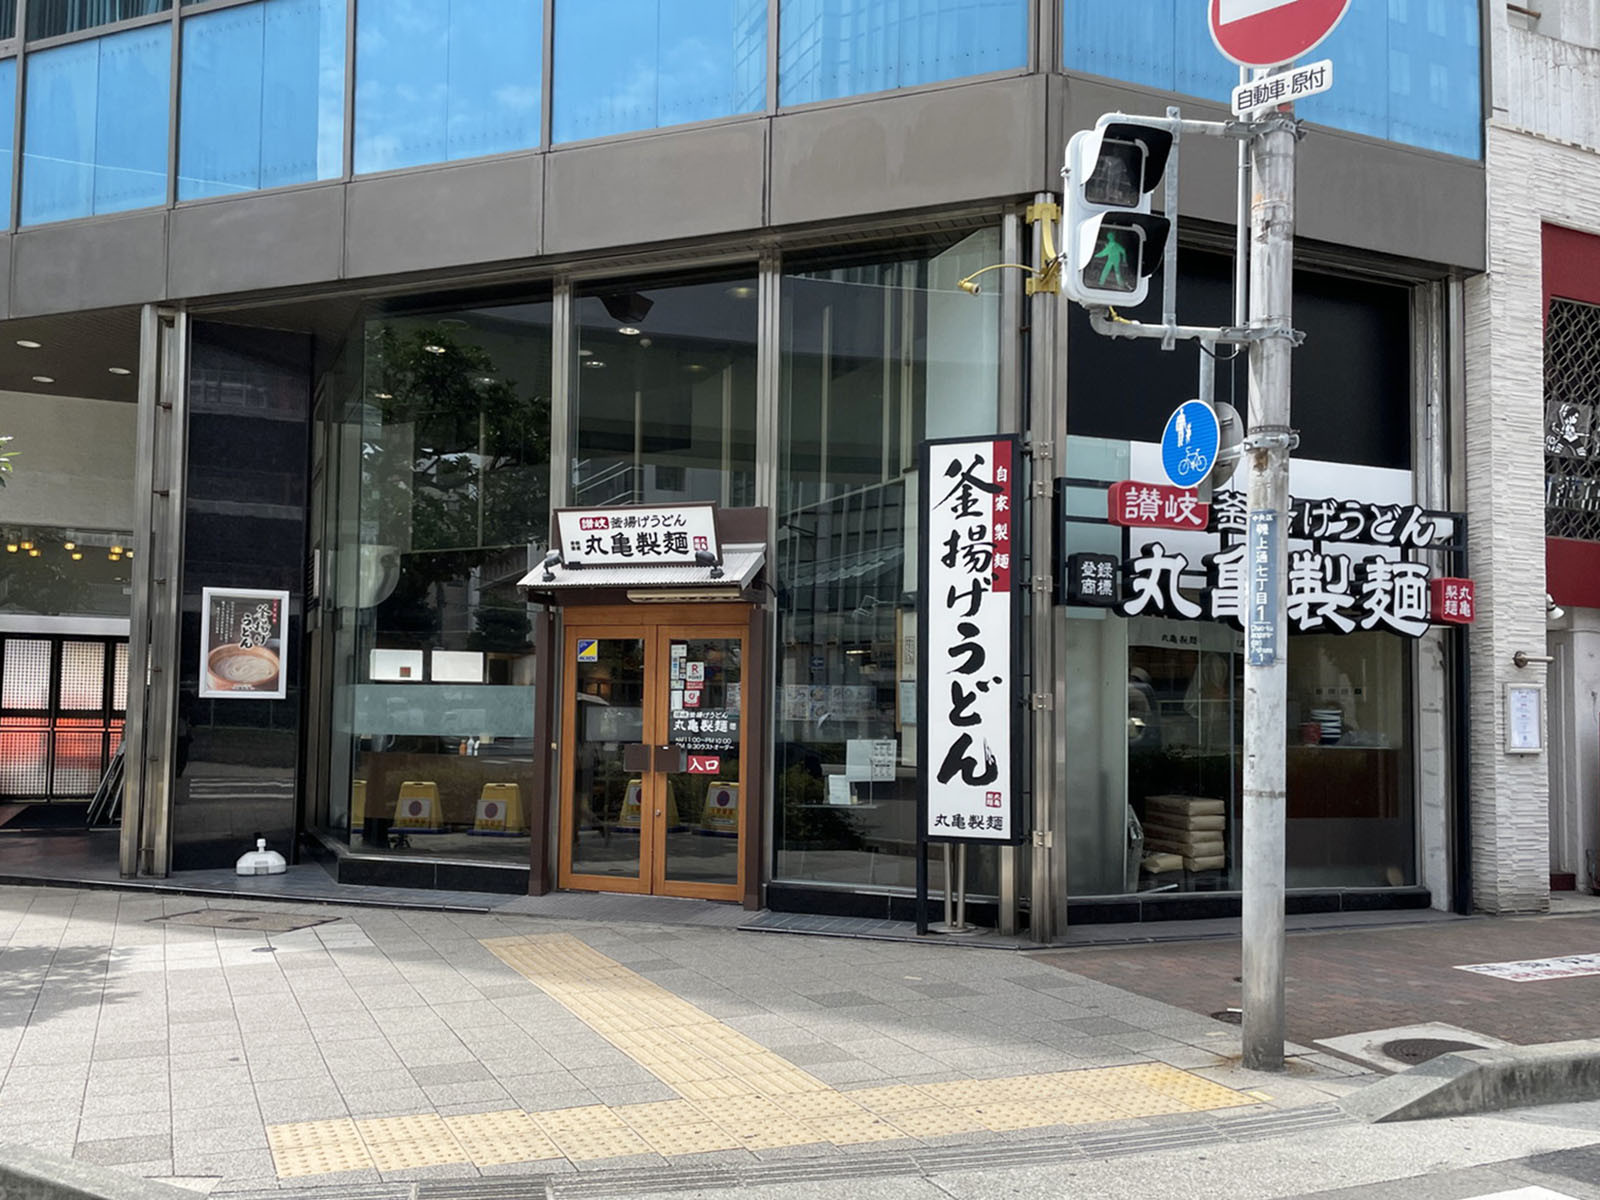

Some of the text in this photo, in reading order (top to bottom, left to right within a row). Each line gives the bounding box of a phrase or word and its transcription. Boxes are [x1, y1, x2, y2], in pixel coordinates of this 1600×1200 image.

[610, 513, 687, 529] 釜揚げうどん
[994, 465, 1010, 569] 自家製麺
[1125, 486, 1203, 526] 讃岐
[1213, 489, 1438, 547] 釜げうどん
[584, 530, 690, 558] 丸亀製麺
[932, 453, 1004, 786] 釜揚げうどん
[689, 757, 719, 771] 入口
[934, 813, 1004, 831] 丸亀製麺
